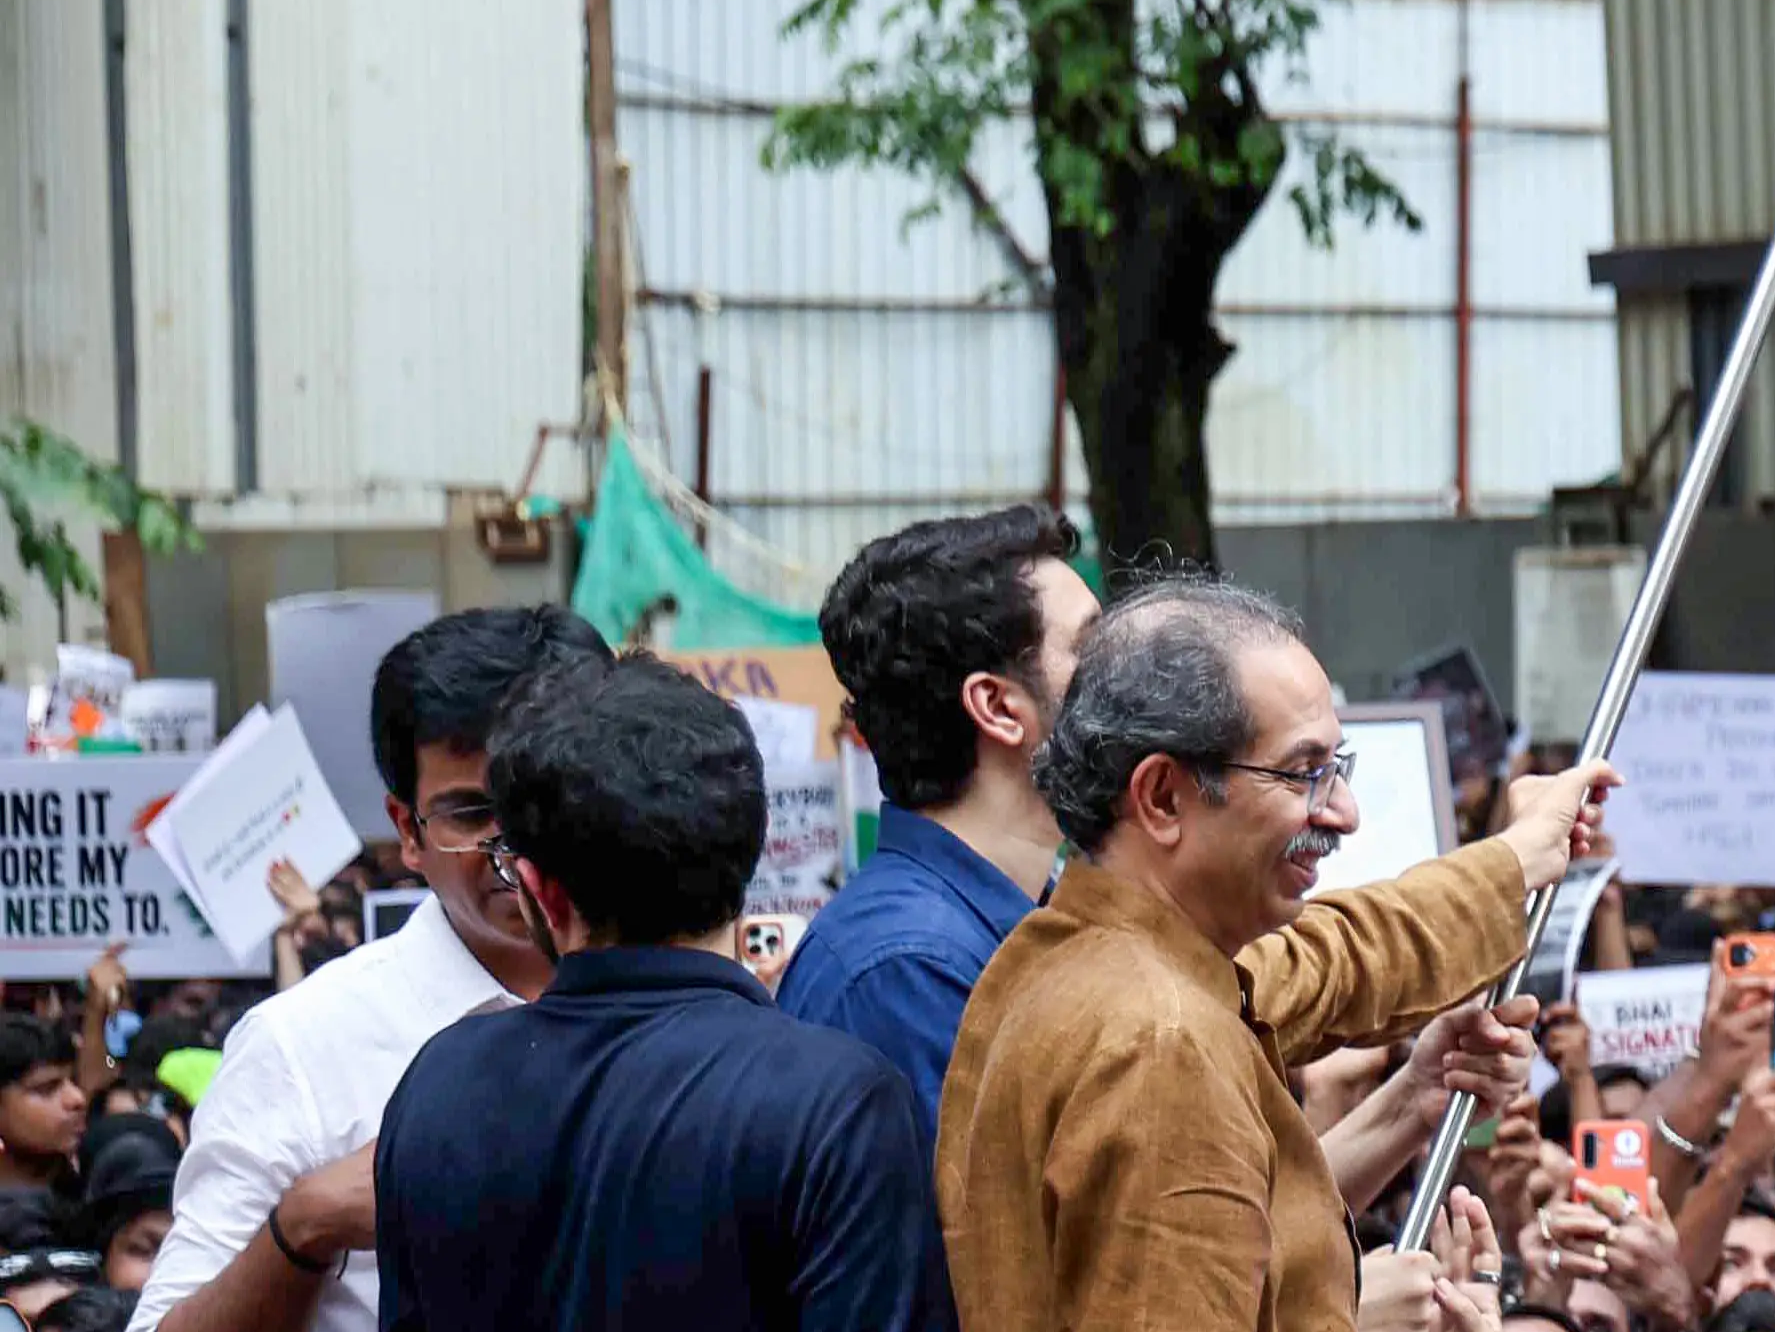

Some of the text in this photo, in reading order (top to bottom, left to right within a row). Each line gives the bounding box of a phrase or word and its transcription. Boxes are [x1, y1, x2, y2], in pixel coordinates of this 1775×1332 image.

[76, 788, 112, 838] IT
[85, 845, 129, 888] MY
[4, 893, 110, 938] NEEDS
